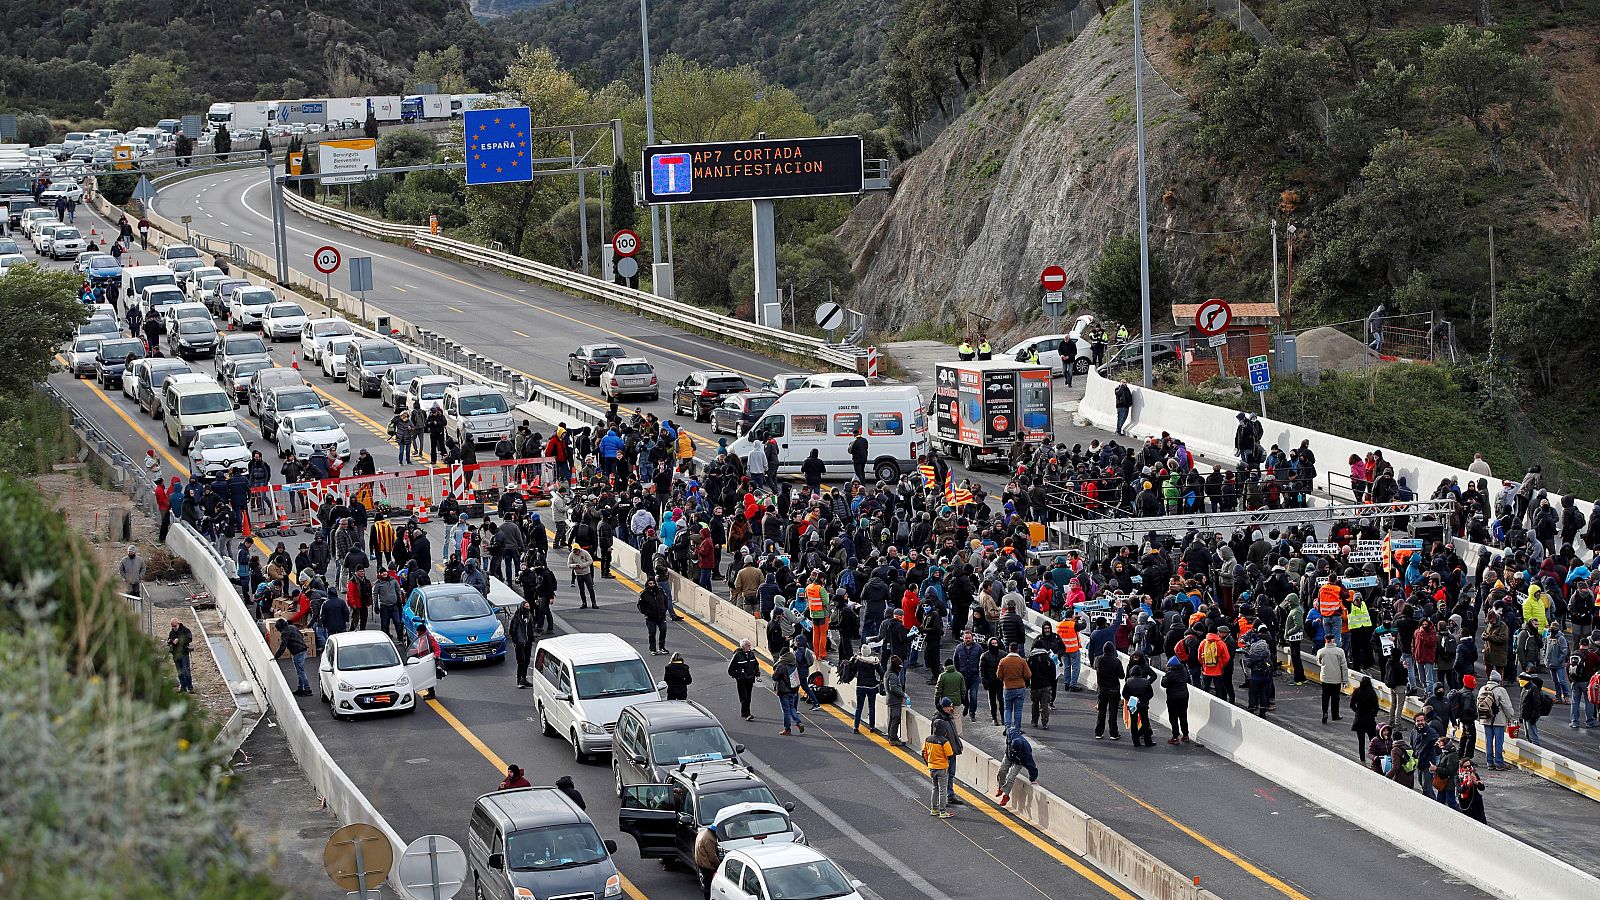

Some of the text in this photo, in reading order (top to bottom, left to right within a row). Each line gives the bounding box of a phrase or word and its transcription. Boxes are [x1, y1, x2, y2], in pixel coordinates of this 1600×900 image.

[481, 141, 515, 150] ESPAÑA
[694, 146, 802, 164] AP7 CORTADA
[694, 160, 823, 178] MANIFESTACION
[617, 239, 635, 248] 100
